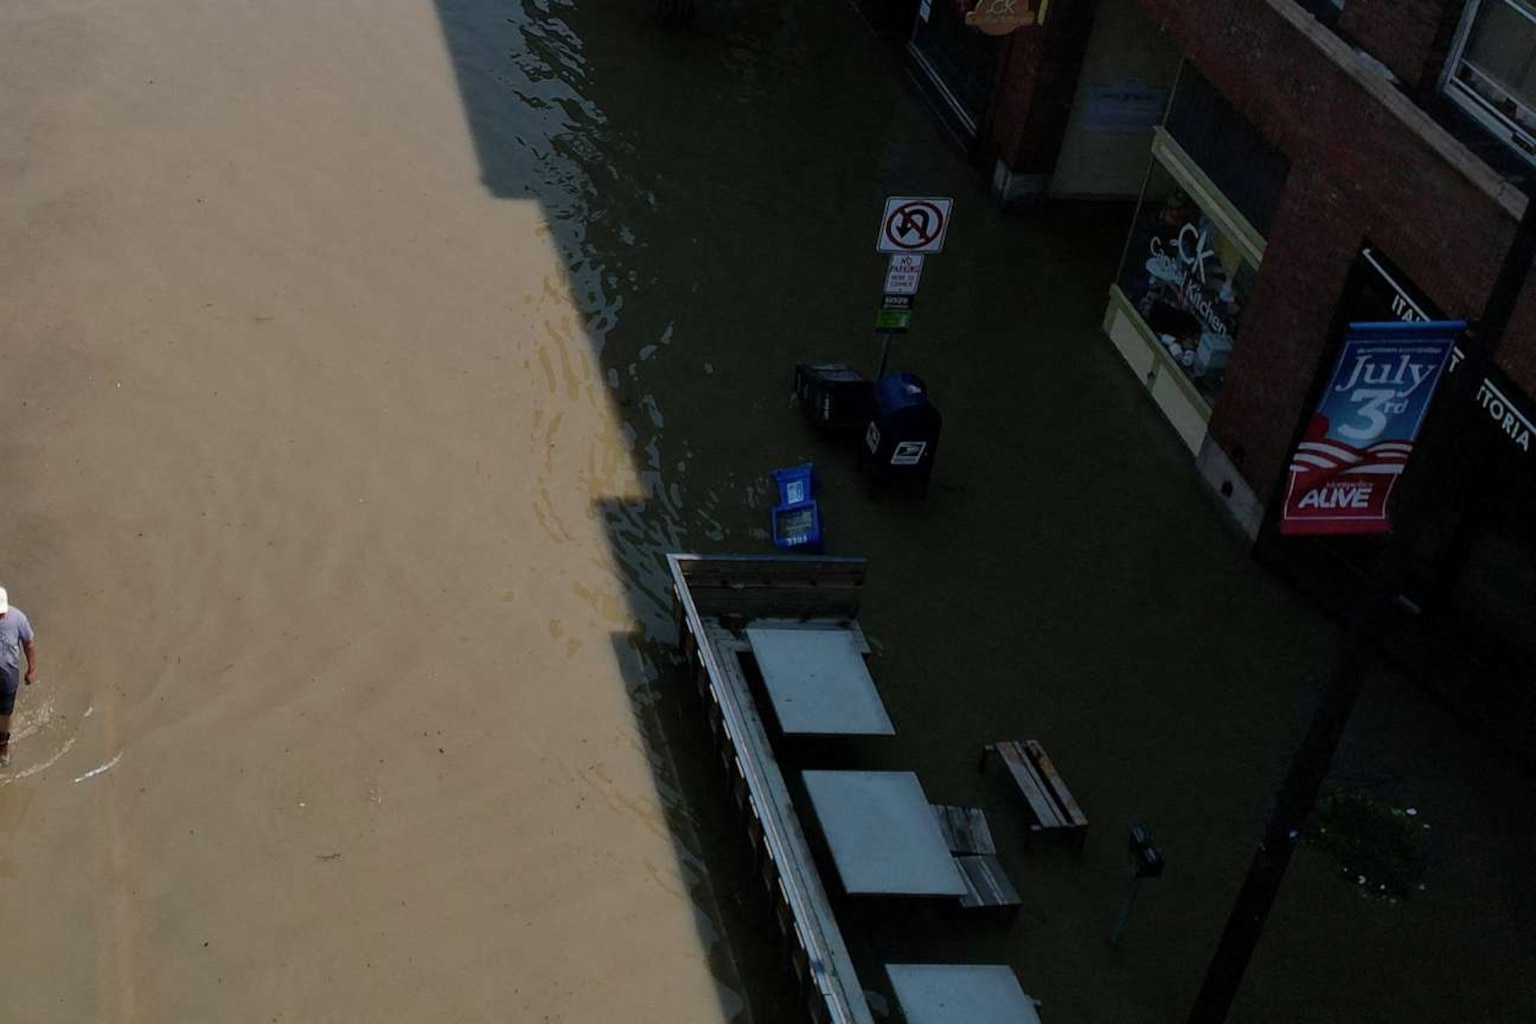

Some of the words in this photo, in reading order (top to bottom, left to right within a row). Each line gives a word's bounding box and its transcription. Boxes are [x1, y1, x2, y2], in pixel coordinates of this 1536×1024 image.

[1334, 353, 1436, 398] July
[1337, 388, 1409, 440] 3rd
[1298, 488, 1373, 509] ALIVE
